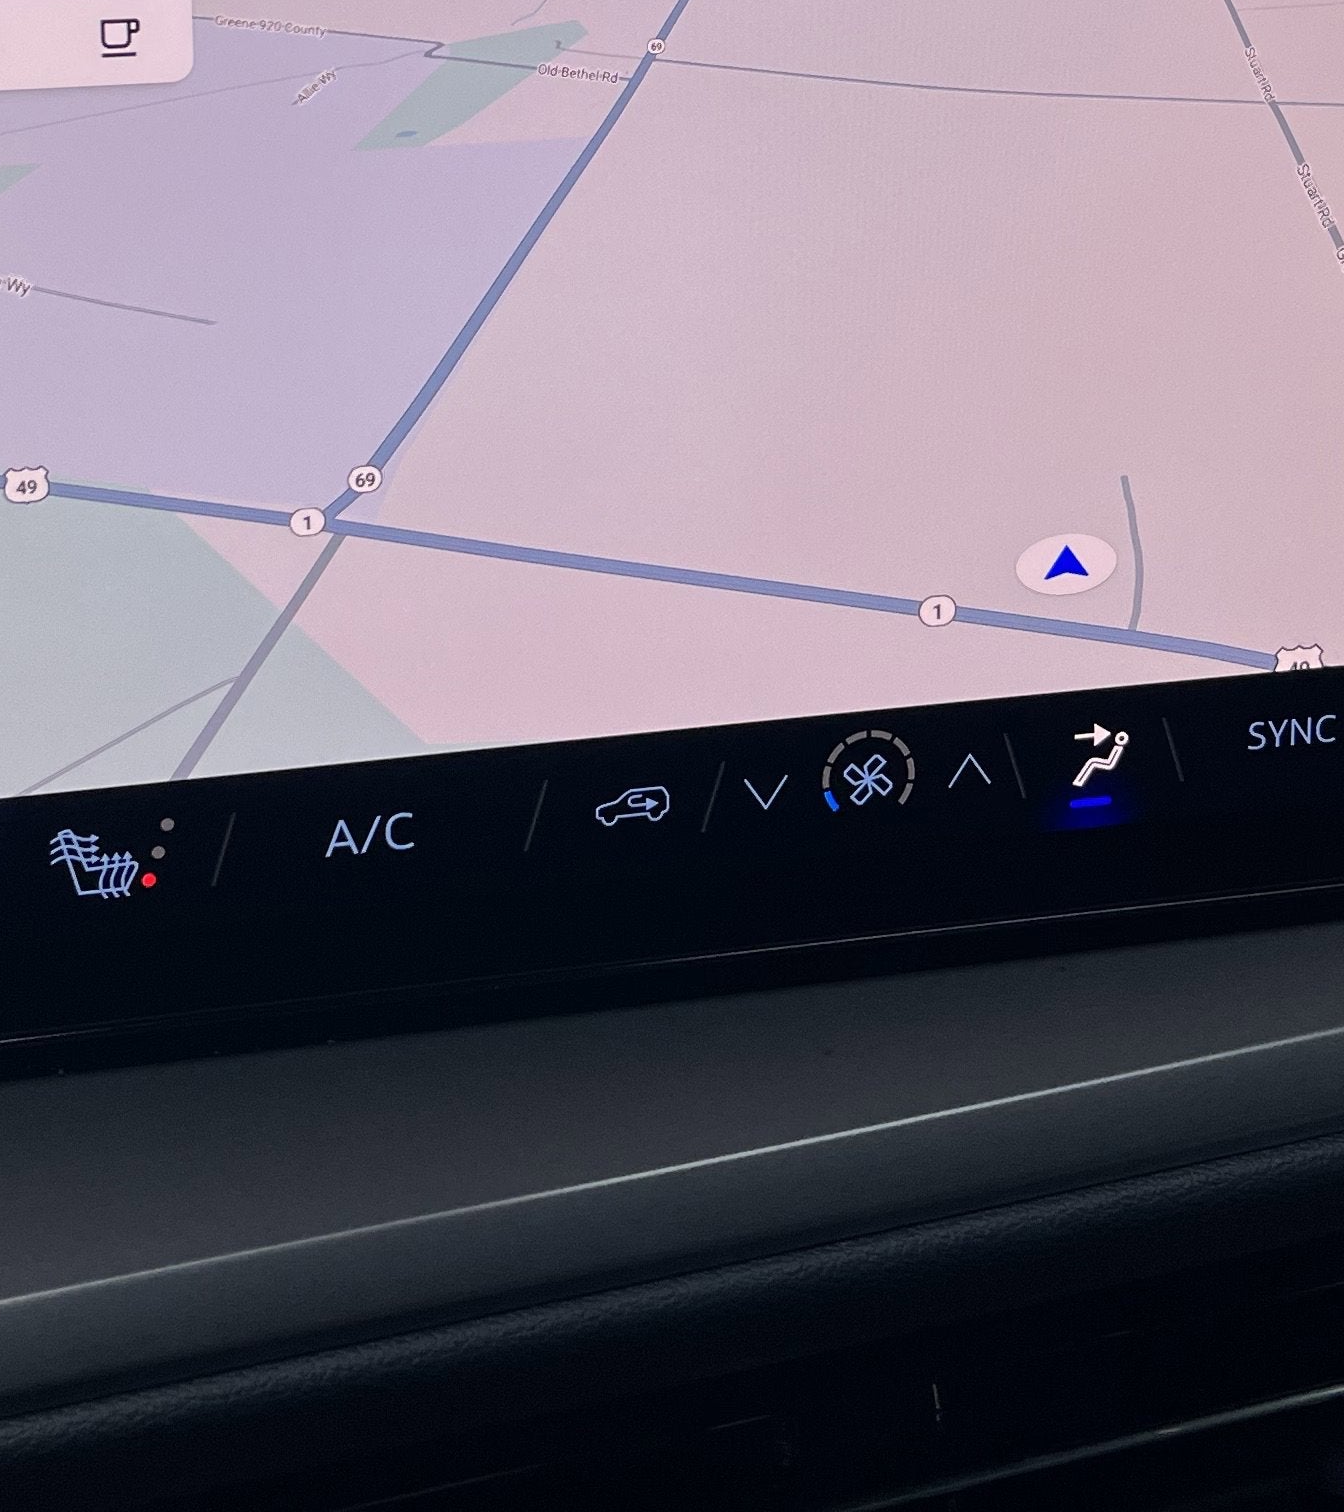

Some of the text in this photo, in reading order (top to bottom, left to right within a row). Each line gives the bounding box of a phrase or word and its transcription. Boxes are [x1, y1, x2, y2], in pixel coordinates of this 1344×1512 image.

[215, 15, 257, 29] Greene
[284, 22, 328, 38] County
[537, 63, 619, 84] Old Bethel Rd
[1245, 46, 1267, 85] Stuart
[1296, 162, 1335, 229] Stuart Rd
[6, 278, 32, 297] Wy
[15, 479, 38, 495] 49
[355, 472, 376, 488] 69
[302, 514, 312, 530] 1
[933, 603, 941, 620] 1
[1247, 714, 1337, 750] SYNC
[324, 811, 416, 858] A/C
